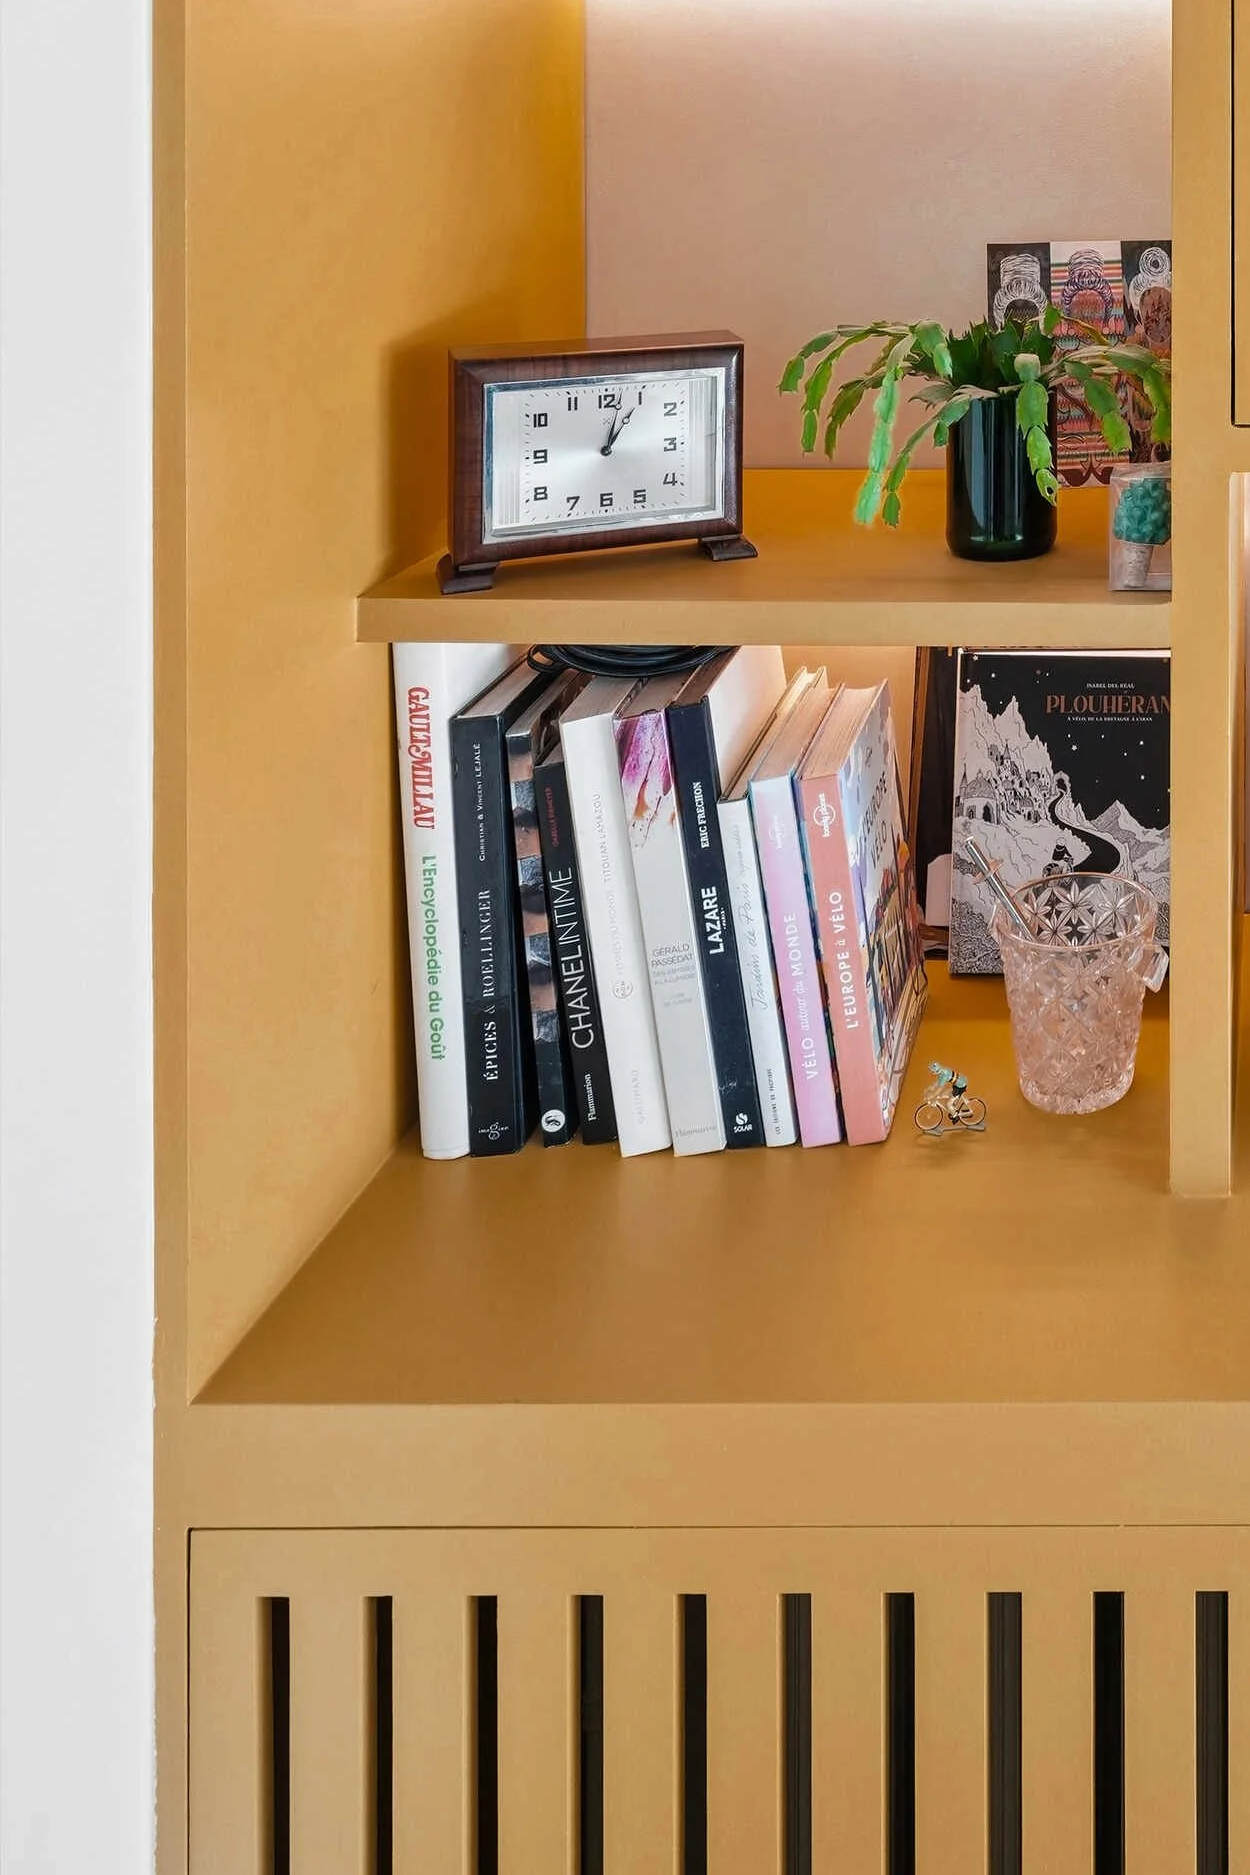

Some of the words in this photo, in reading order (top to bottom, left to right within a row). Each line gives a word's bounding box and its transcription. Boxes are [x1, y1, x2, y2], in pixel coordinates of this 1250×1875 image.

[567, 396, 578, 411] 11
[598, 393, 616, 409] 12
[663, 402, 678, 416] 2
[533, 412, 549, 428] 10
[663, 437, 678, 452] 3
[533, 449, 548, 464] 9
[662, 472, 678, 486] 4
[533, 486, 548, 501] 8
[600, 492, 613, 507] 6
[633, 489, 647, 504] 5
[566, 496, 580, 511] 7
[693, 781, 707, 825] FRECHON
[699, 825, 710, 849] ERIC
[422, 854, 443, 989] L'Encyclopédie
[701, 886, 725, 955] LAZARE
[829, 892, 846, 938] VÉLO
[479, 889, 495, 998] ROELLINGER
[783, 913, 803, 983] MONDE
[839, 951, 860, 1030] L'EUROPE
[429, 991, 441, 1014] du
[483, 1004, 496, 1015] &
[429, 1016, 445, 1061] Goût
[482, 1021, 499, 1081] ÉPICES
[801, 1037, 819, 1081] VÉLO
[582, 1073, 597, 1122] Flammarion
[733, 1124, 753, 1134] SOLAR
